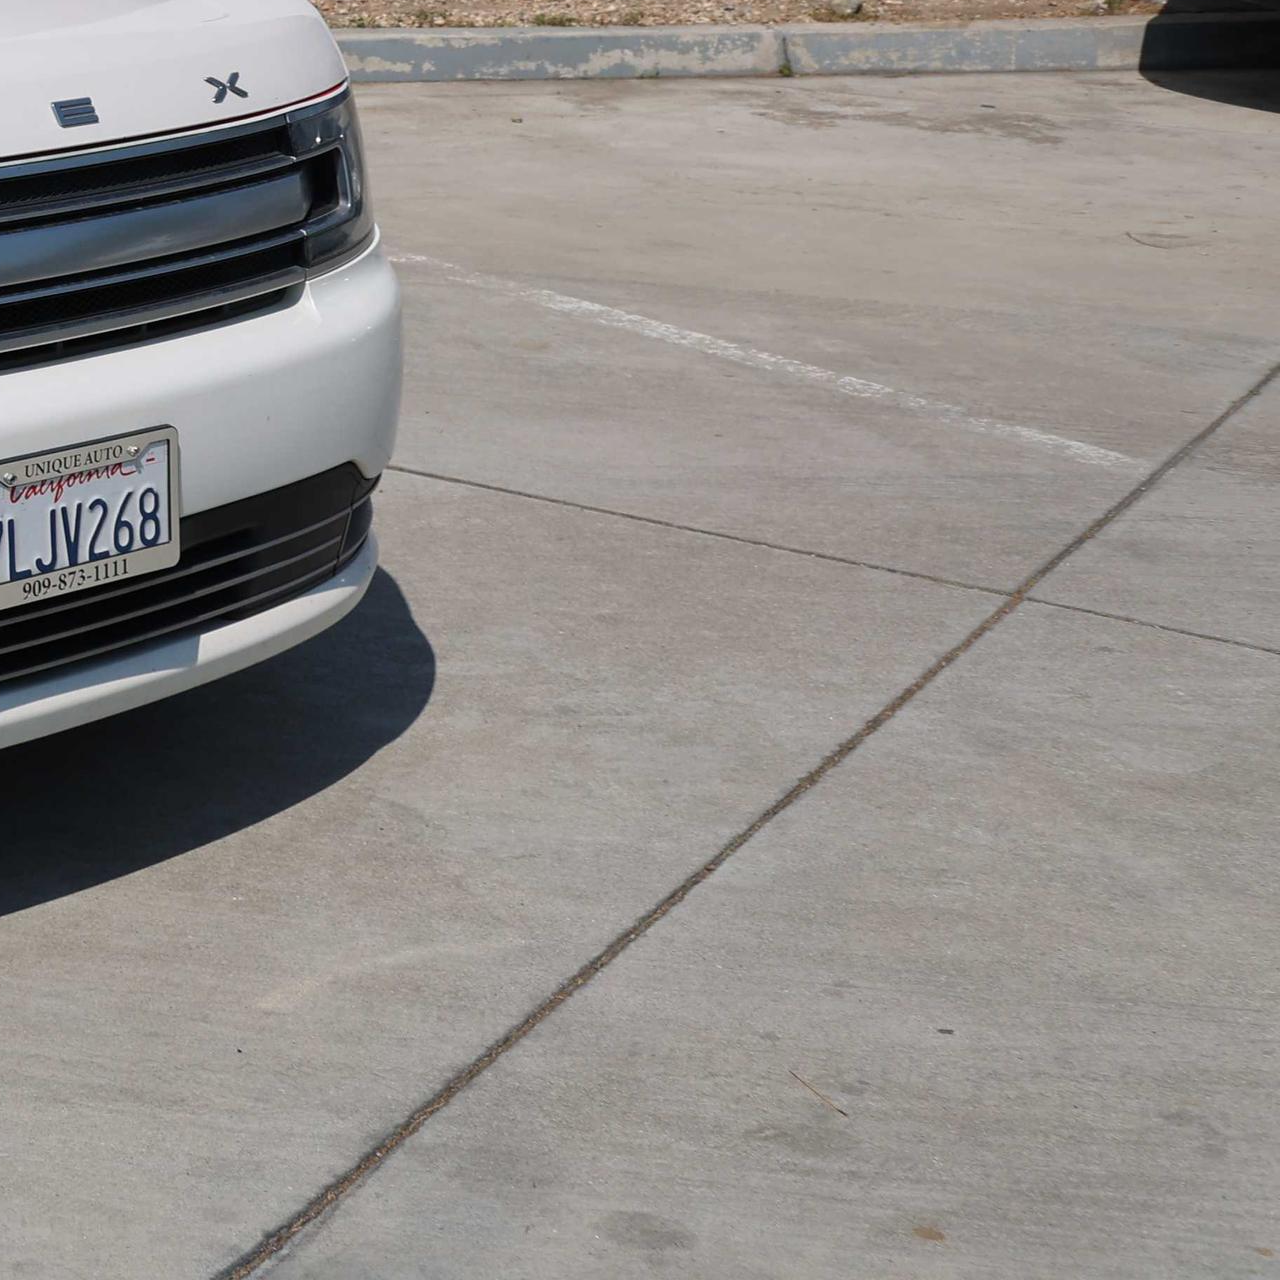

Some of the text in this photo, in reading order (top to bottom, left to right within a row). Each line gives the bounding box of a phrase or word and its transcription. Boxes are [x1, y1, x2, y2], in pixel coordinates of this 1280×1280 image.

[24, 444, 123, 479] UNIQUE AUTO
[22, 558, 130, 601] 909-873-1111
